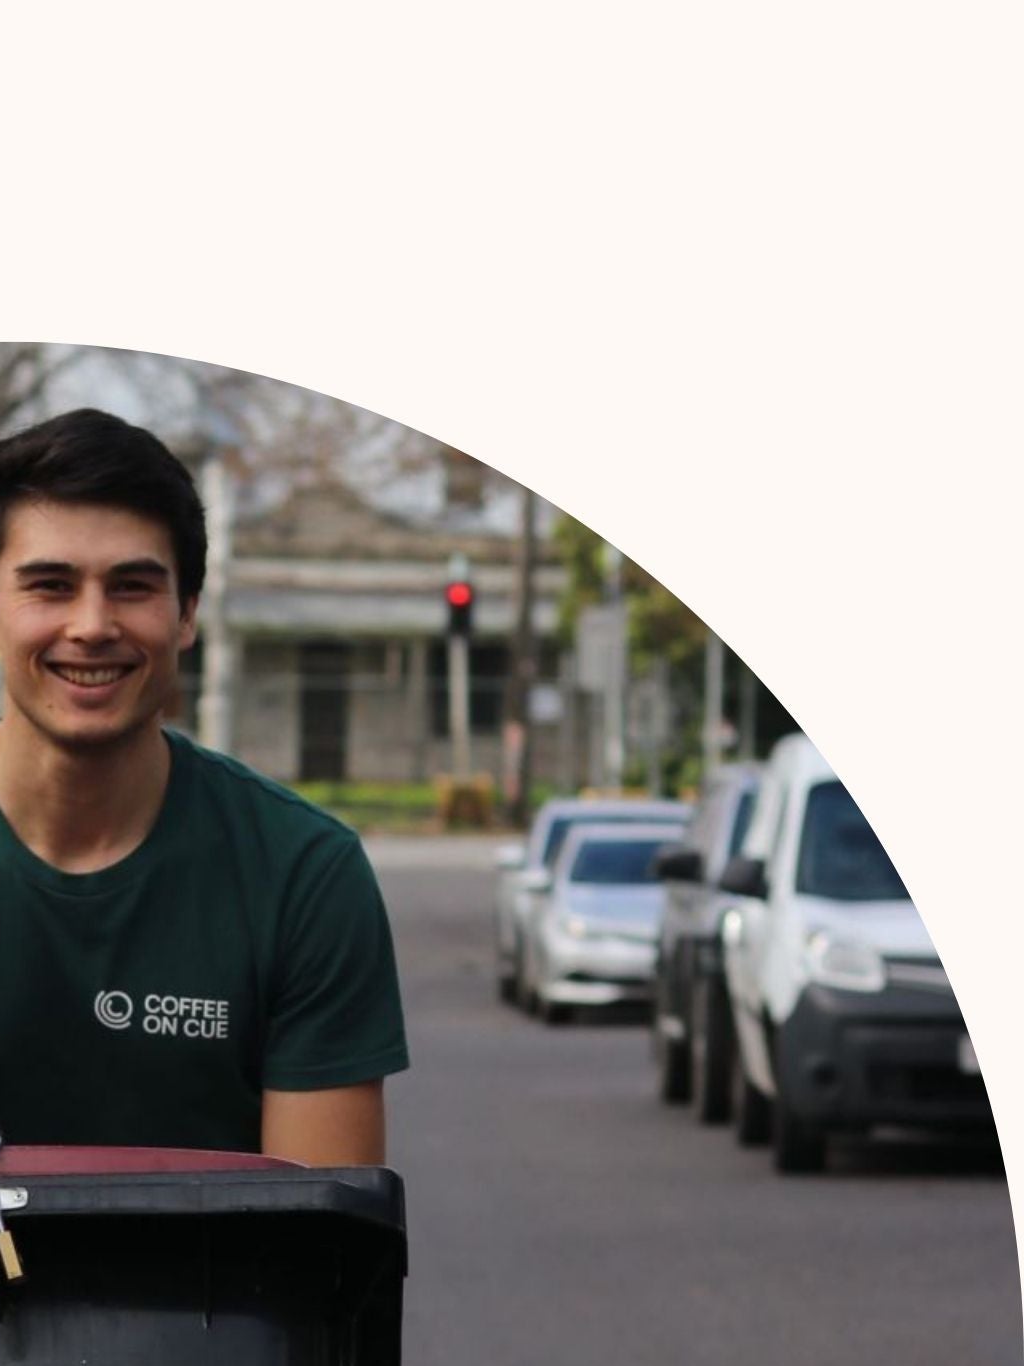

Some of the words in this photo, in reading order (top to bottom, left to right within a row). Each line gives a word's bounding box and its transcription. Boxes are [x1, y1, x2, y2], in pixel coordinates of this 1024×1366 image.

[144, 994, 229, 1019] COFFEE
[143, 1015, 178, 1036] ON
[183, 1018, 229, 1039] CUE
